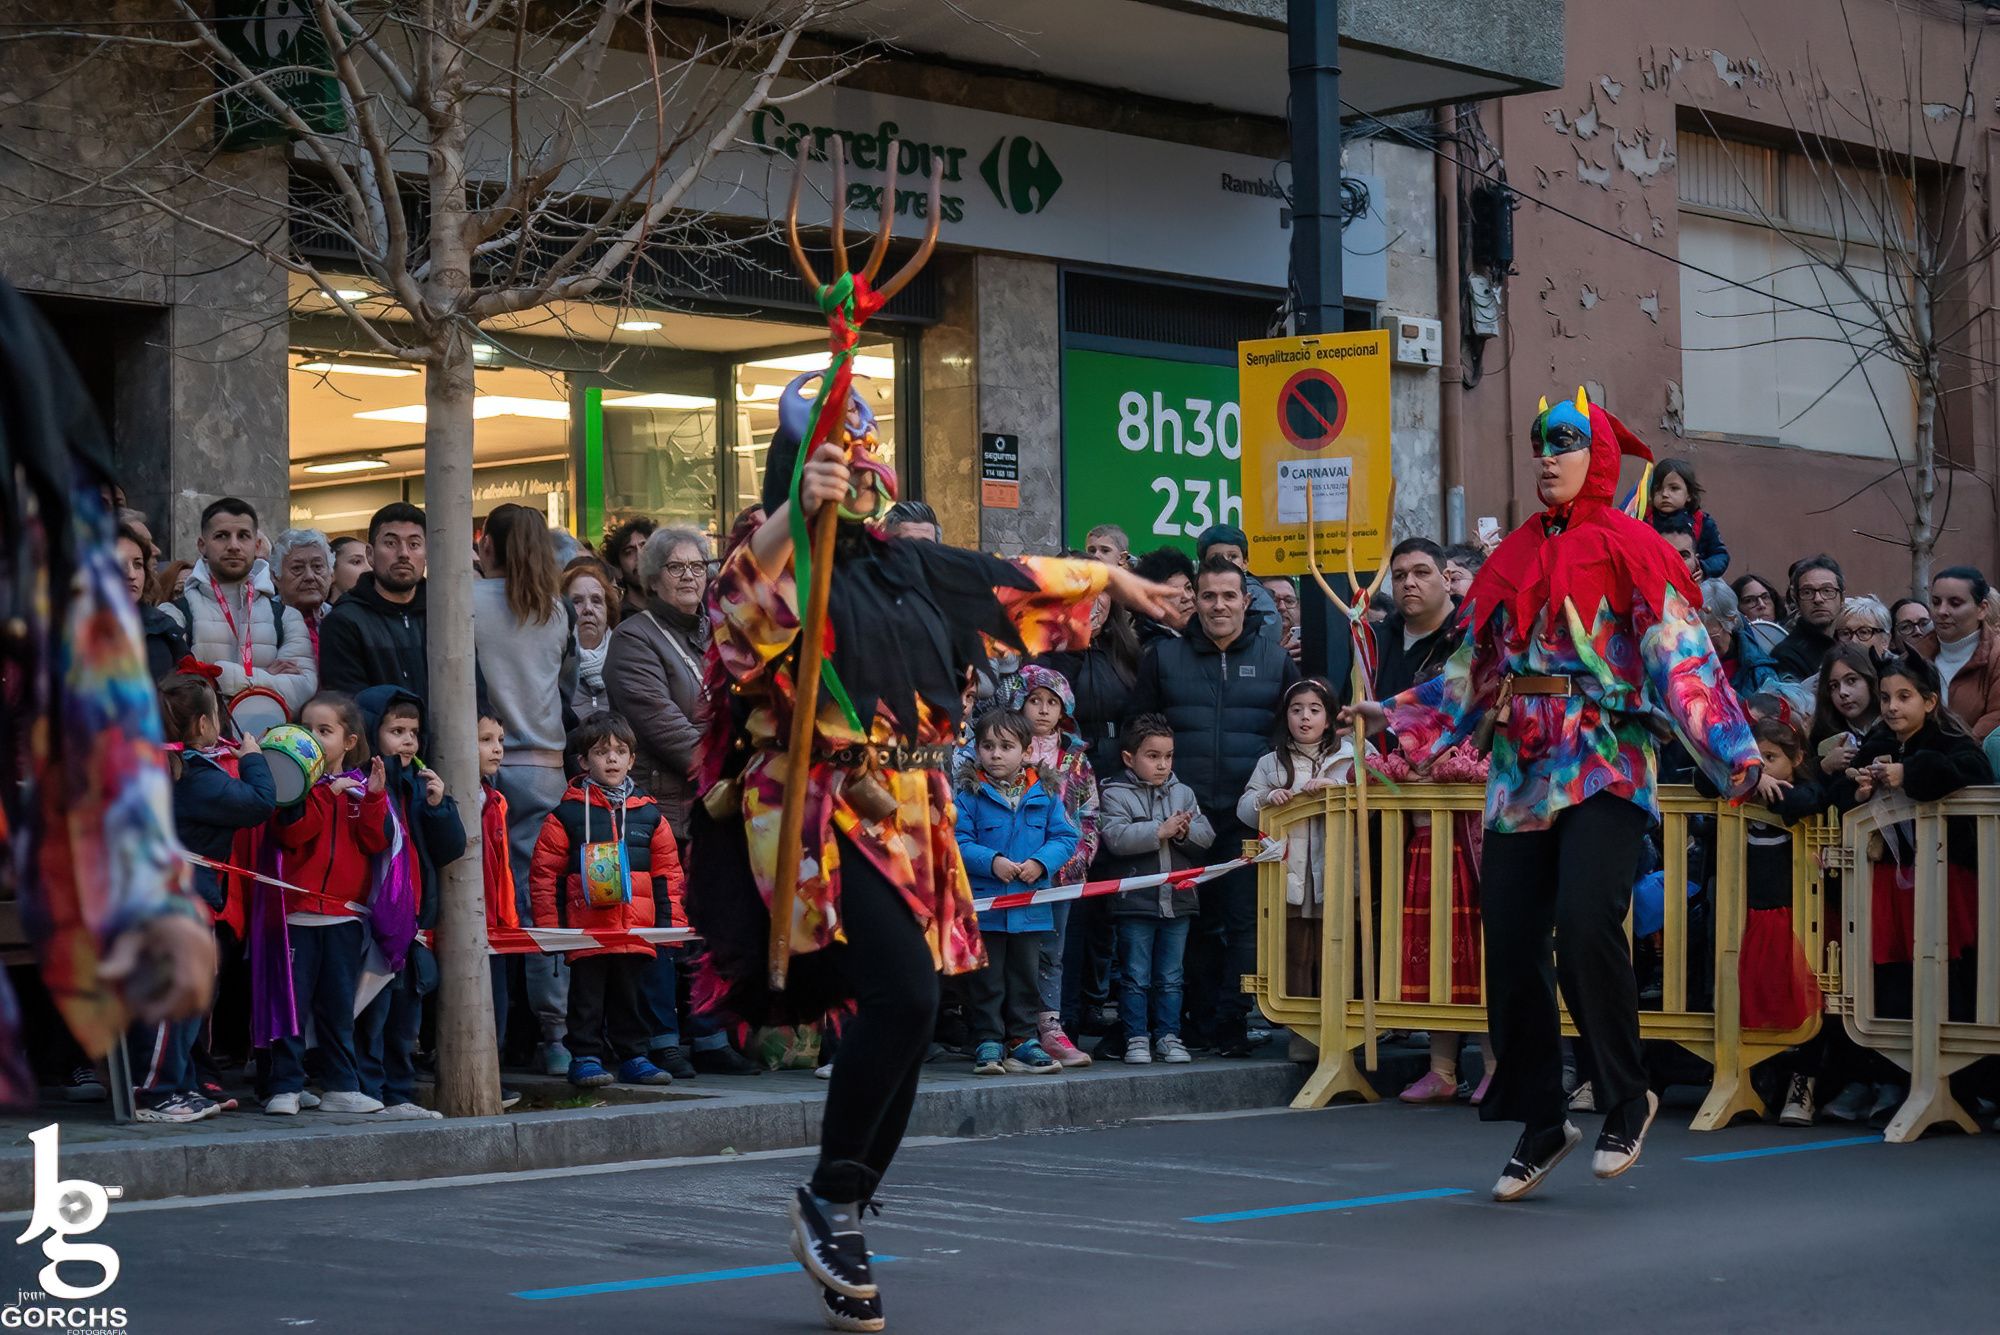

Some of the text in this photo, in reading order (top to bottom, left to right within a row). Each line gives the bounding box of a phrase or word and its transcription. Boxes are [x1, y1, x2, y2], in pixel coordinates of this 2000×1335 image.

[846, 183, 965, 223] exres
[1246, 341, 1379, 367] Senyalització excepcional
[1118, 391, 1242, 460] 8h30
[1292, 466, 1350, 480] CARNAVAL
[1151, 476, 1243, 539] 23h
[1284, 534, 1296, 542] per
[1297, 533, 1305, 541] la
[1326, 529, 1378, 539] col·laoració
